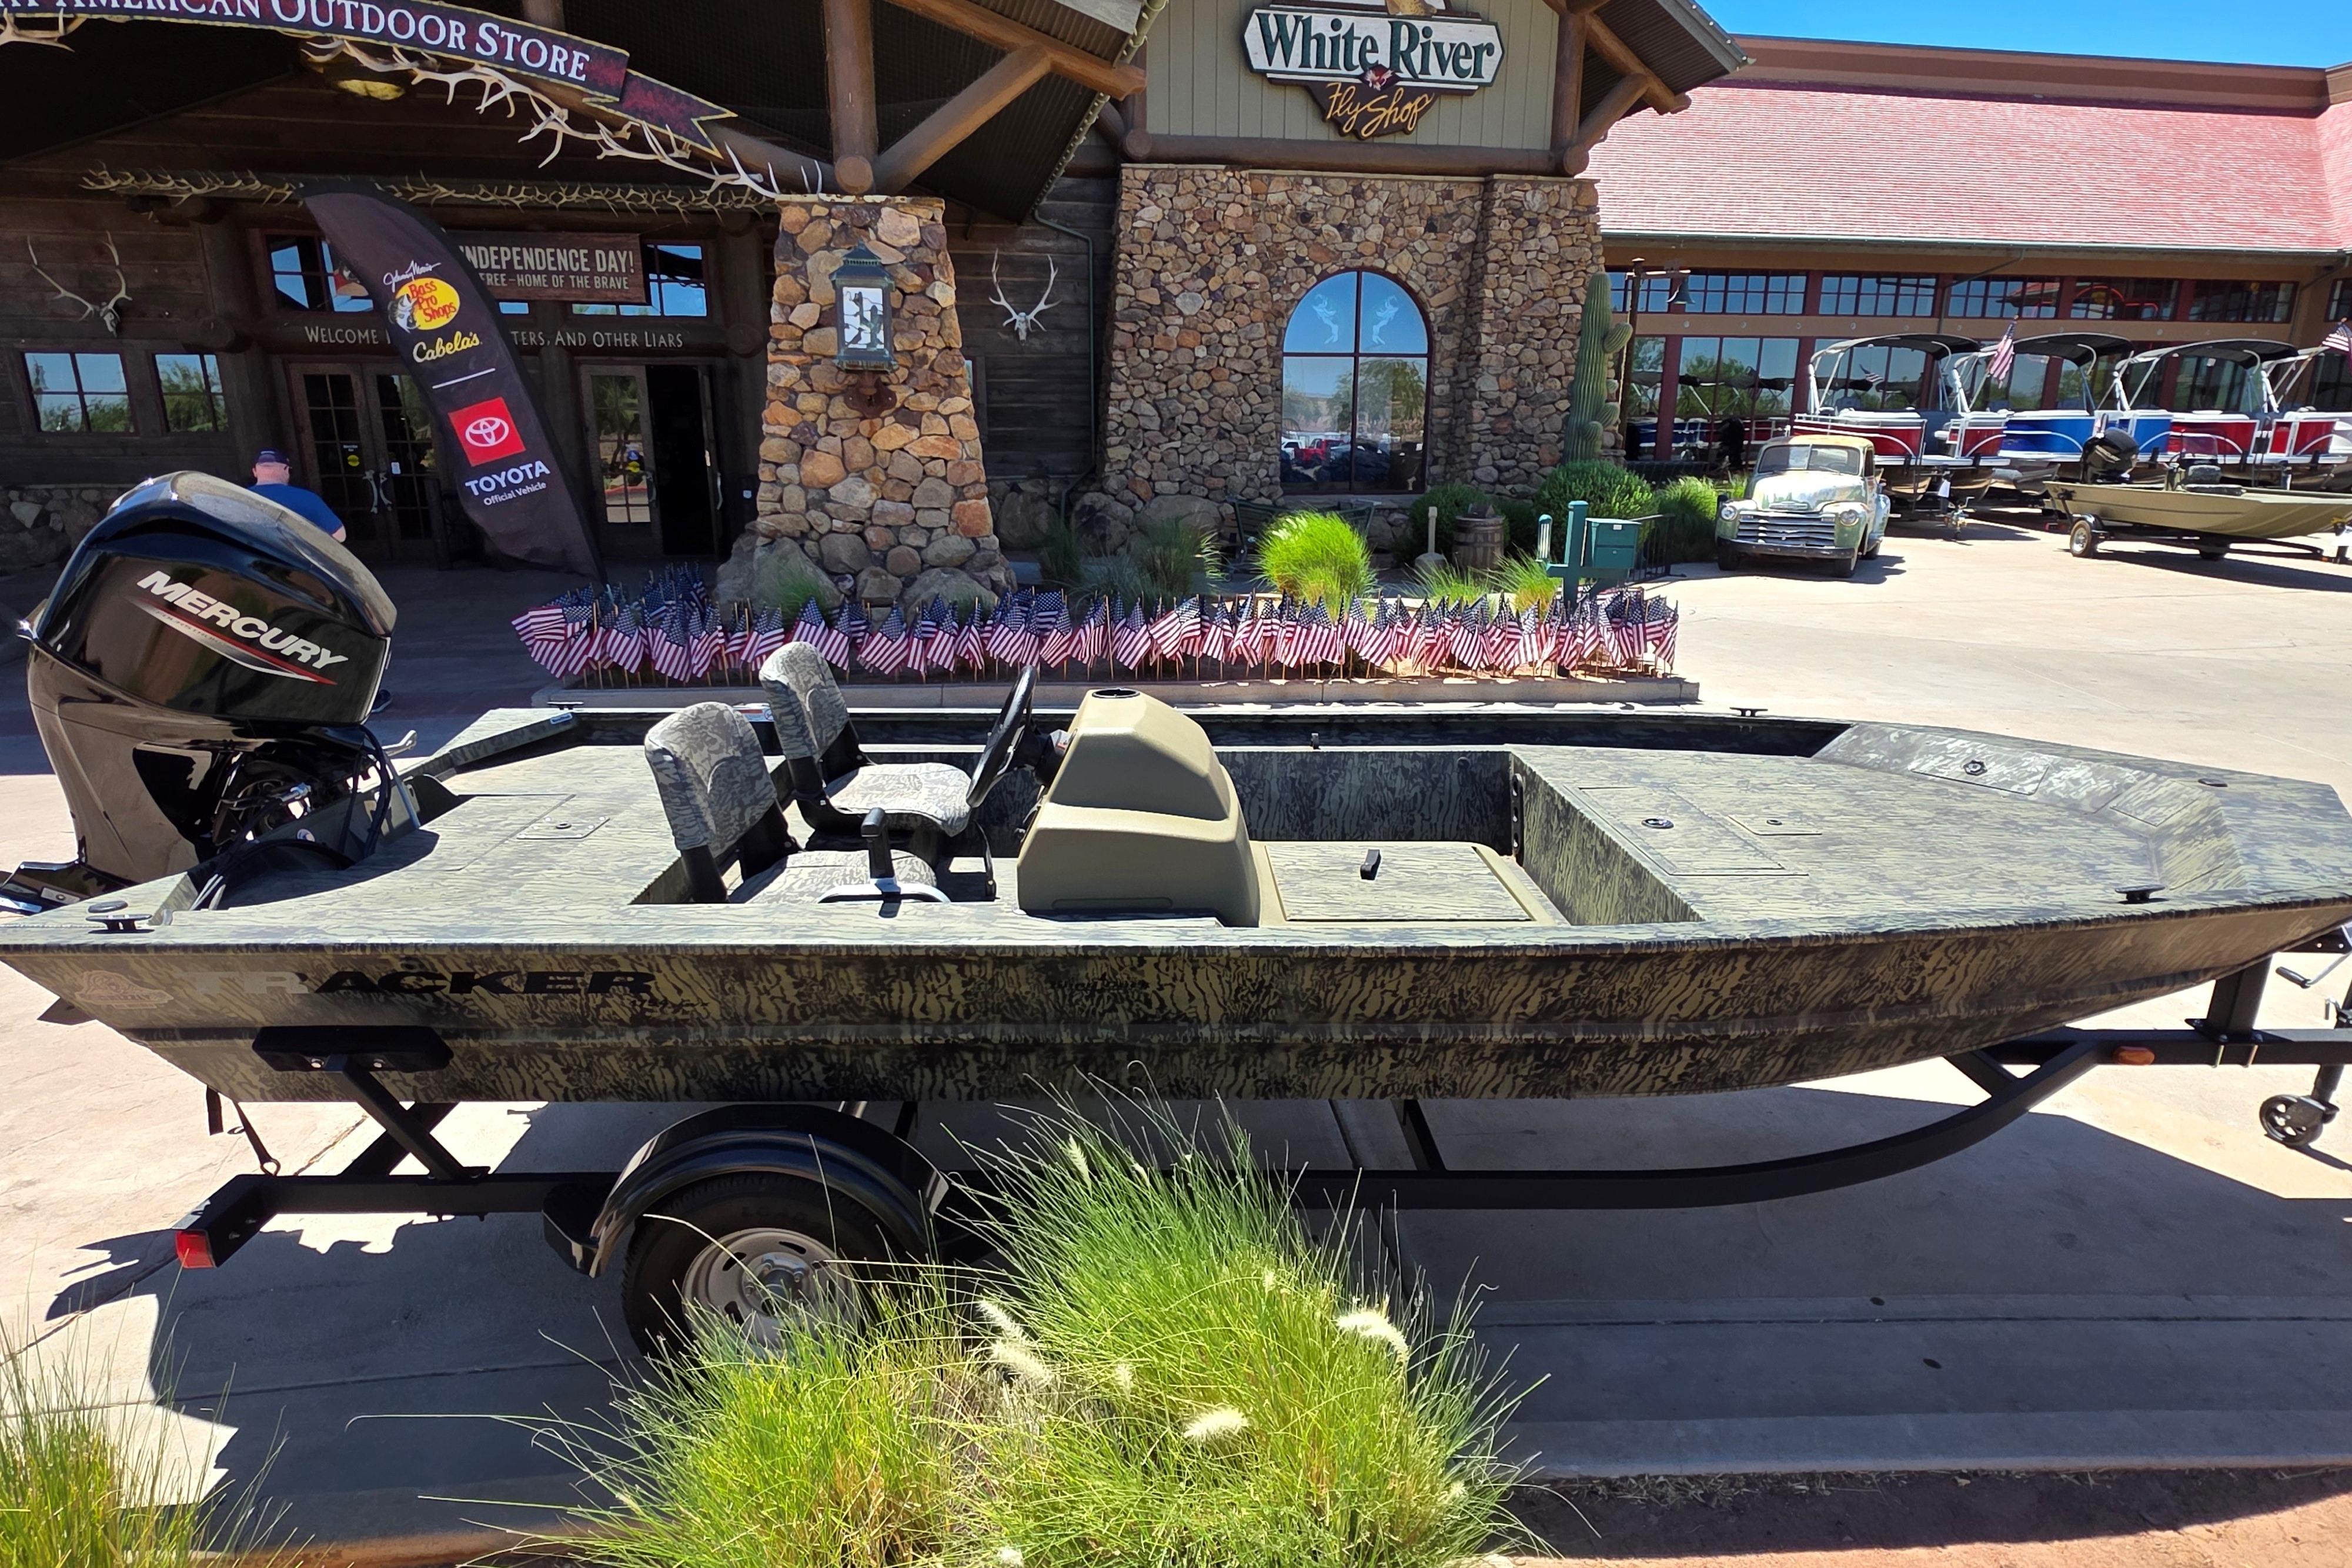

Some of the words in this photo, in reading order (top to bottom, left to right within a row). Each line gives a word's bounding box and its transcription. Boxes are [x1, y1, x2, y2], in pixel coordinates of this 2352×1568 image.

[271, 0, 466, 50] OUTDOOR
[476, 22, 590, 81] STORE
[1255, 12, 1379, 71] White
[1388, 19, 1495, 79] River
[1325, 82, 1367, 133] Fly
[1360, 86, 1435, 138] Shop
[594, 249, 635, 273] DAY!
[409, 280, 437, 299] Bass
[552, 274, 565, 287] OF
[569, 275, 592, 289] THE
[594, 276, 630, 290] BRAVE
[417, 295, 438, 311] Pro
[423, 302, 457, 323] Shops
[304, 326, 379, 345] WELCOME
[554, 331, 587, 346] AND
[593, 332, 639, 347] OTHER
[644, 331, 683, 348] LIARS
[412, 330, 480, 363] Cabela's
[465, 460, 550, 496] TOYOTA
[483, 490, 516, 506] Official
[514, 482, 547, 497] Vehicle
[136, 570, 349, 669] MERCURY
[176, 971, 656, 994] TRACKER
